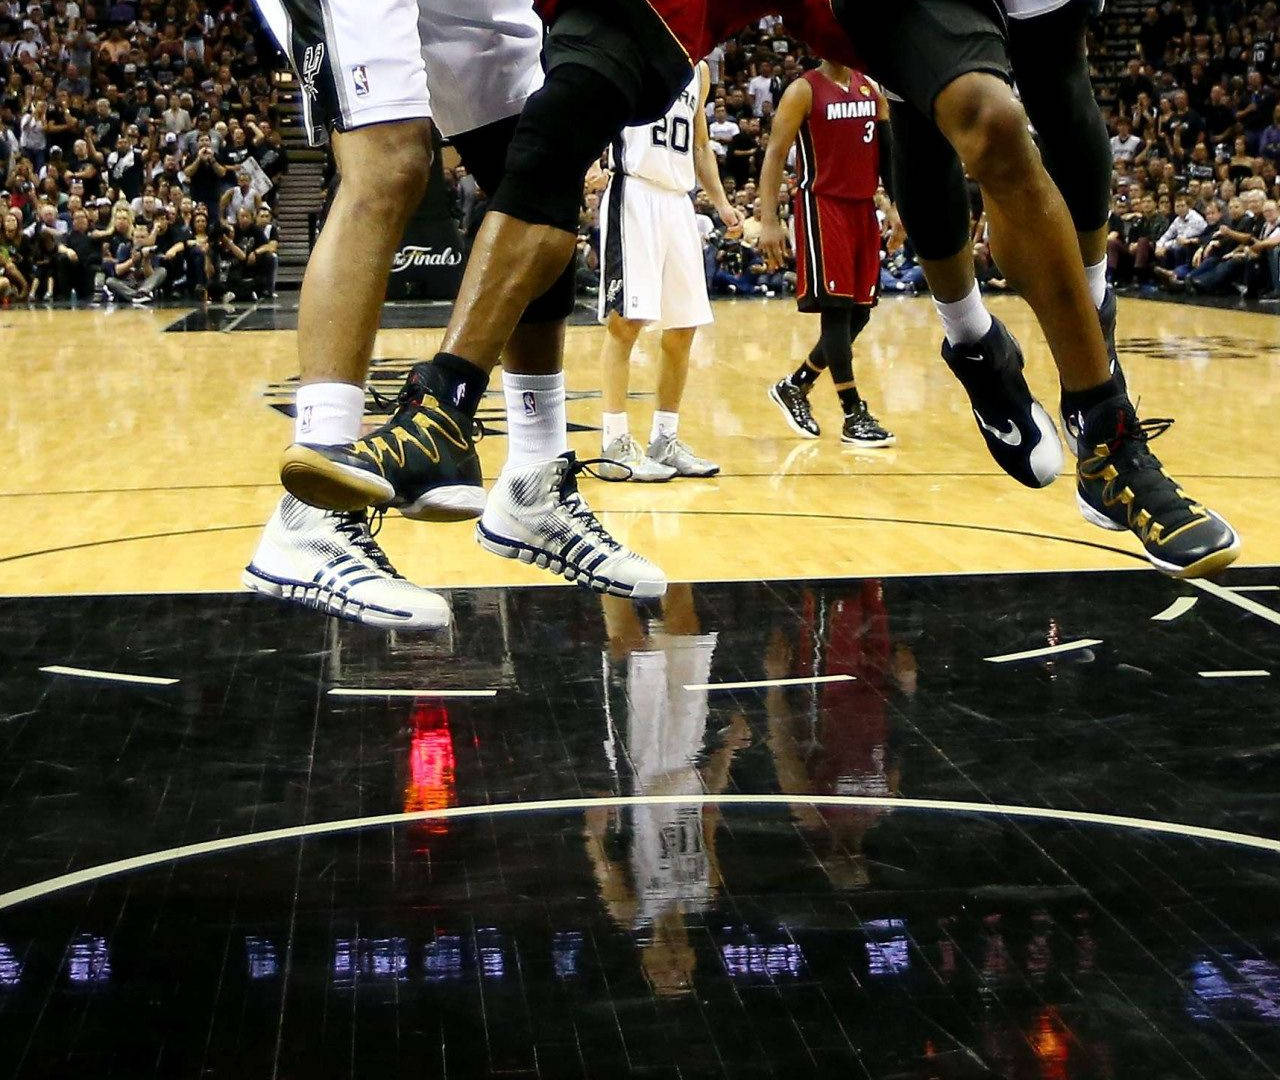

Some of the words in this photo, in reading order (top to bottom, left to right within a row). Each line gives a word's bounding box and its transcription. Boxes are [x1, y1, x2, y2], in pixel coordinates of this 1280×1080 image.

[826, 100, 877, 120] MIAMI
[651, 116, 690, 154] 20
[863, 120, 875, 143] 3
[390, 245, 462, 272] Finals
